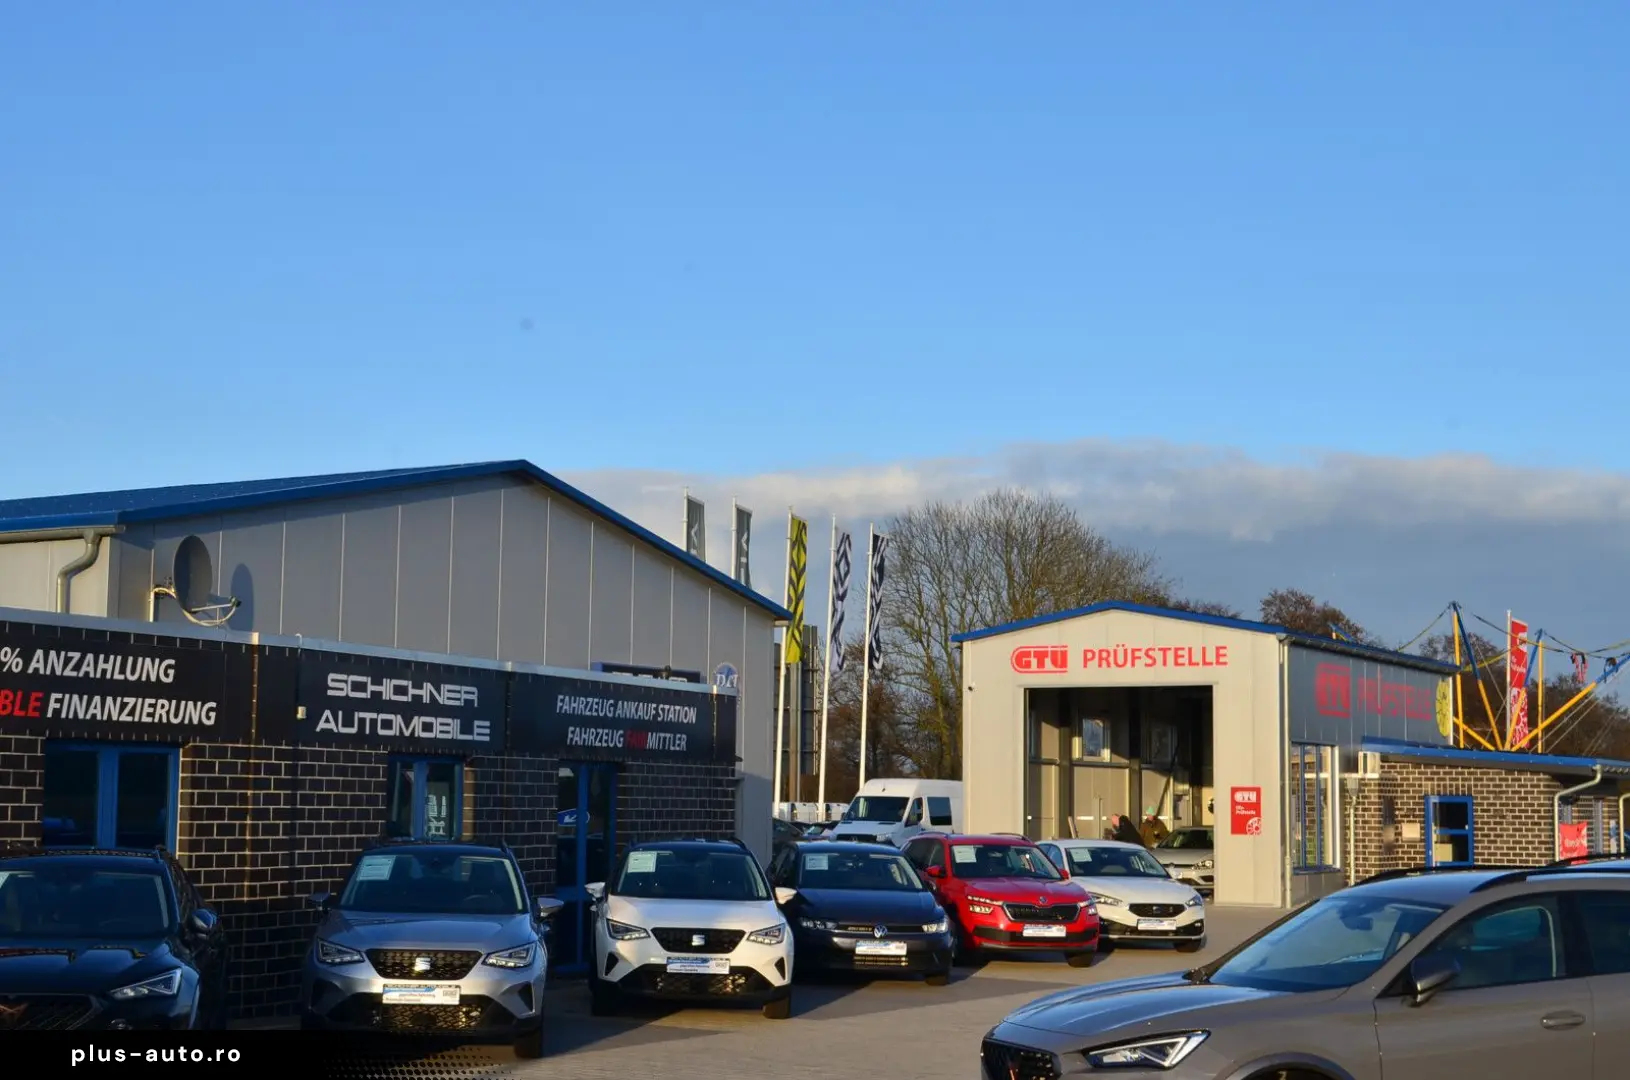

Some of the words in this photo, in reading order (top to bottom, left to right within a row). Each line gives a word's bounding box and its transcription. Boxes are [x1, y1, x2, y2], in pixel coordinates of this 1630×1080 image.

[27, 649, 176, 683] ANZAHLUNG
[1083, 643, 1228, 669] PRÜFSTELLE
[327, 673, 478, 707] SCHICHNER
[47, 693, 217, 726] FINANZIERUNG
[556, 695, 614, 718] FAHRZEUG
[615, 702, 656, 721] ANKAUF
[657, 705, 697, 724] STATION
[316, 710, 491, 741] AUTOMOBILE
[567, 726, 624, 747] FAHRZEUG
